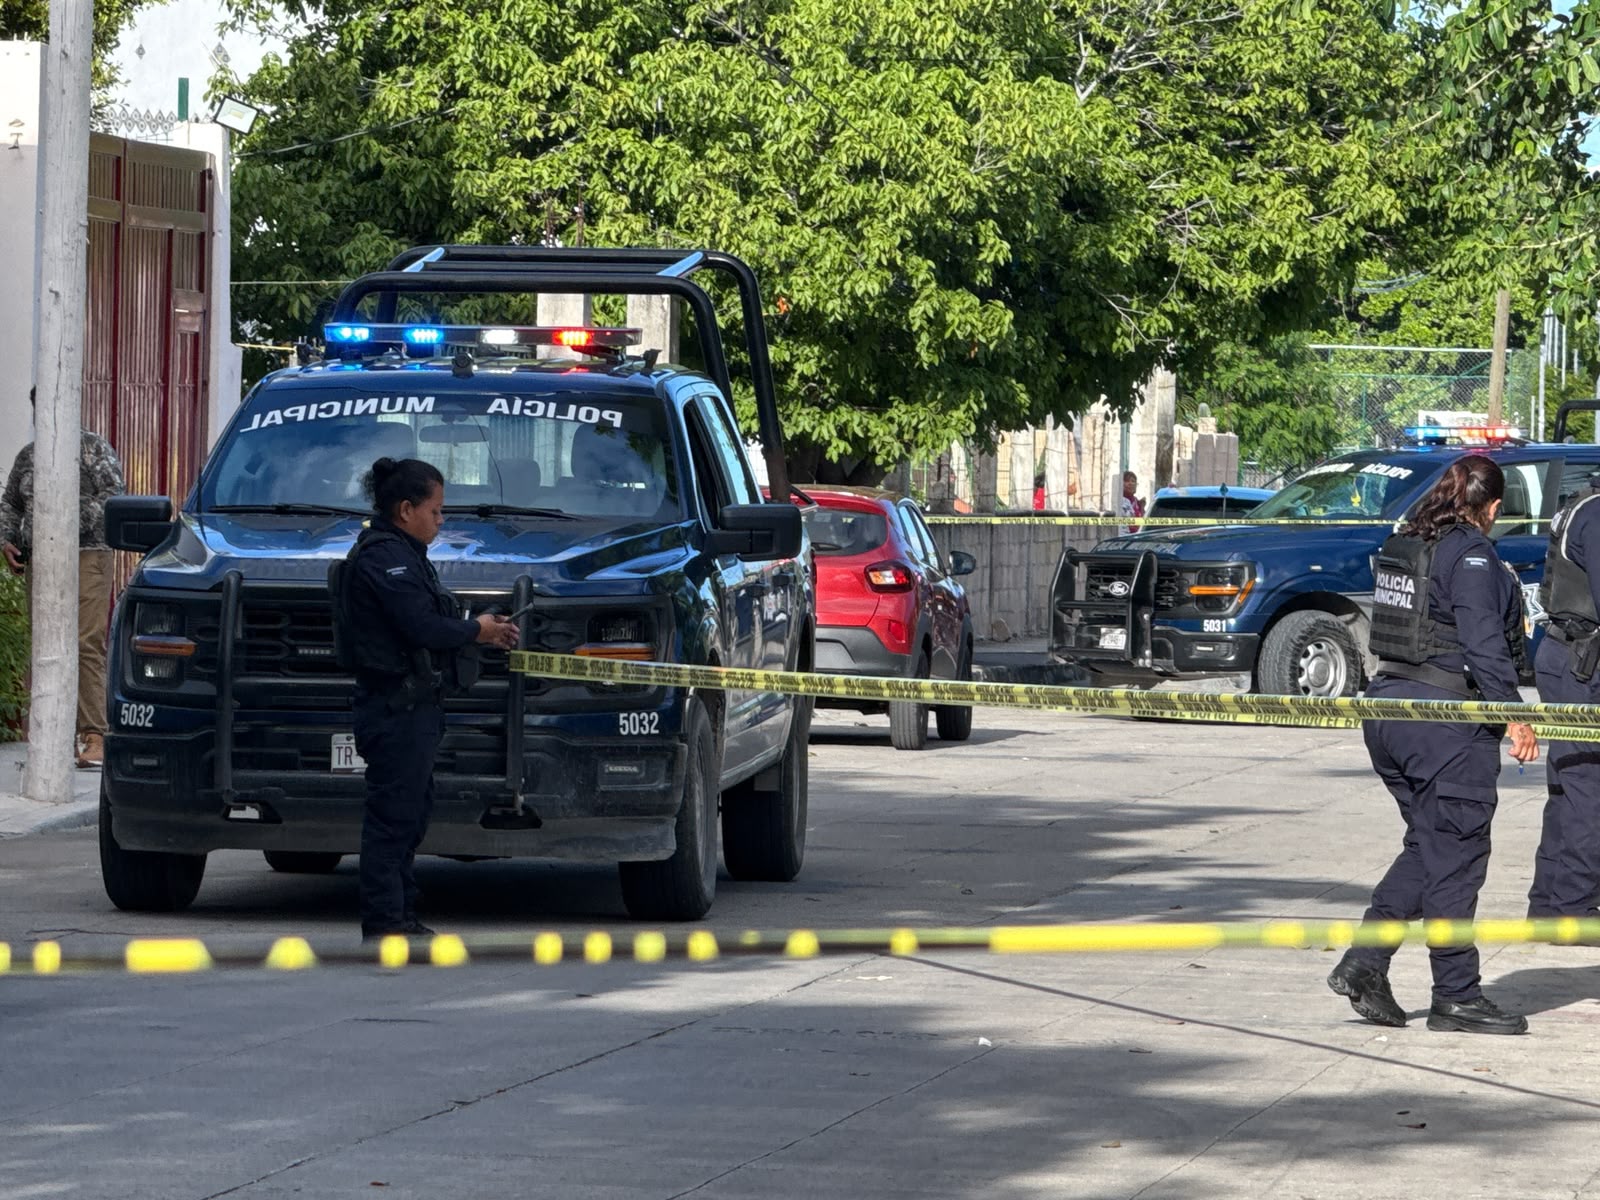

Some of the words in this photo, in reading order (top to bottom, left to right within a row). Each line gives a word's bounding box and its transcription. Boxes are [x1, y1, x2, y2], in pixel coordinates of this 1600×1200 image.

[1203, 619, 1226, 632] 5031
[120, 703, 155, 728] 5032
[619, 712, 660, 735] 5032
